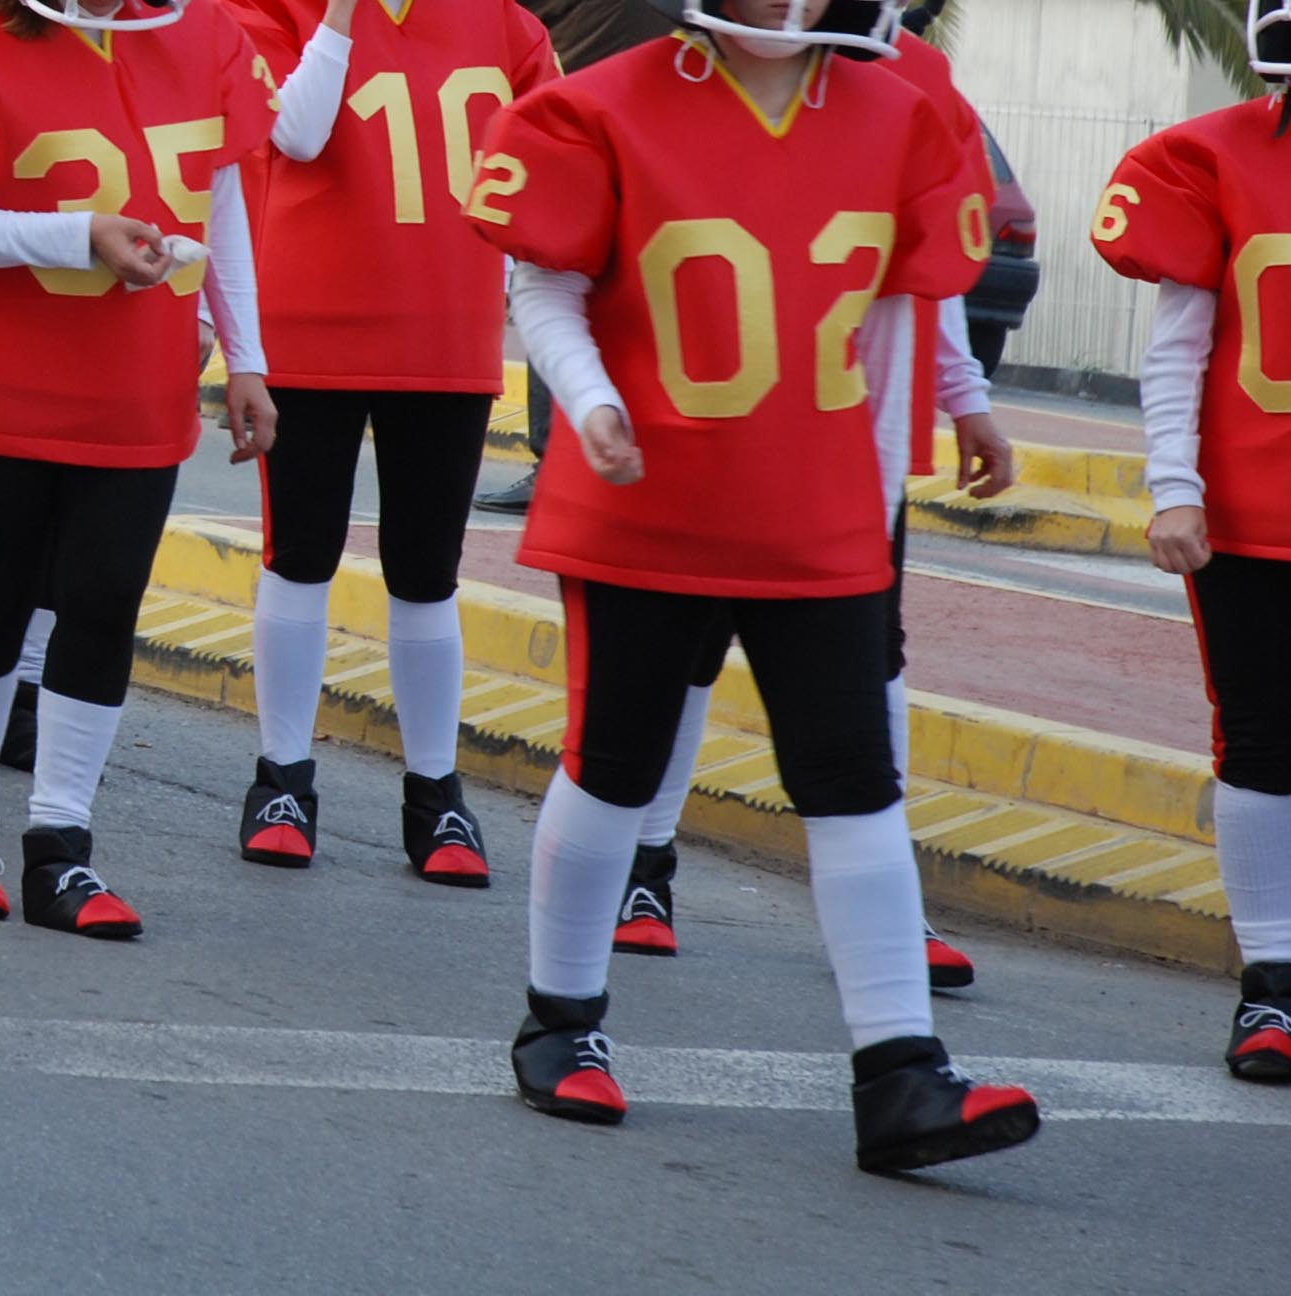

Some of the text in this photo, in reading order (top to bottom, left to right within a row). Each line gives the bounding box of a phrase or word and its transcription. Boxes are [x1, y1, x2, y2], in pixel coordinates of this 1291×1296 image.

[13, 115, 225, 297] 35
[347, 67, 514, 223] 10
[1091, 183, 1141, 242] 6
[958, 193, 992, 262] 0
[639, 210, 896, 419] 02
